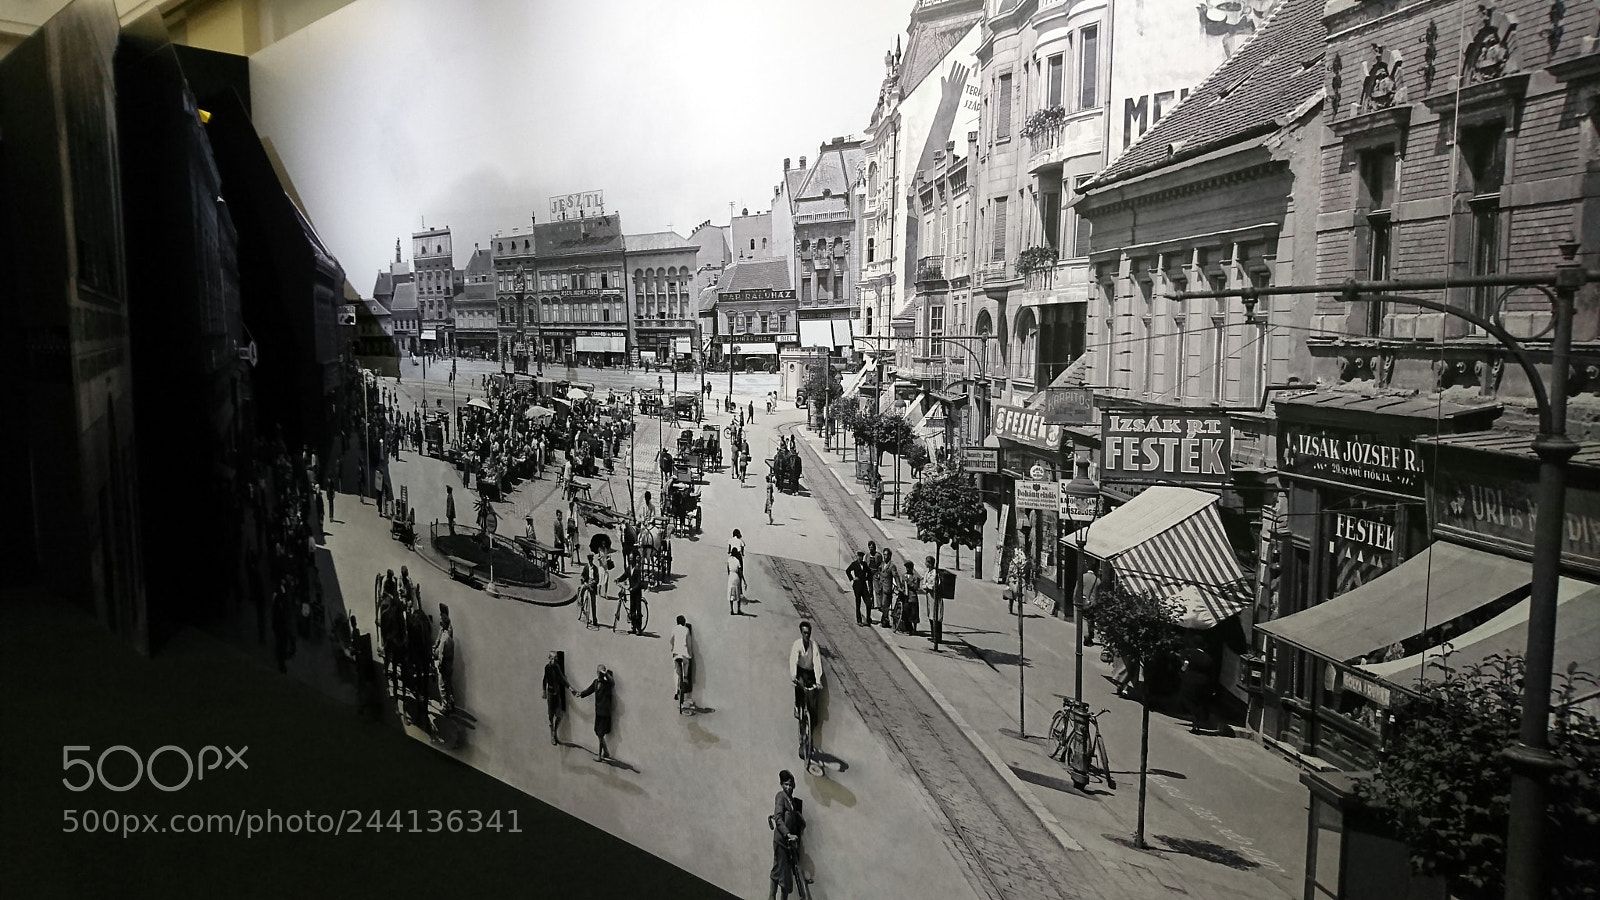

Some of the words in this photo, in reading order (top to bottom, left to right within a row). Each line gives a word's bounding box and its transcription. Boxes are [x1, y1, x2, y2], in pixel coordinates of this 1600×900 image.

[1109, 415, 1182, 432] IZSÁK
[1105, 432, 1226, 475] FESTÉK
[1299, 430, 1340, 460] IZSÁK
[1343, 434, 1401, 469] JÓZSEF
[1336, 513, 1395, 551] FESTÉK
